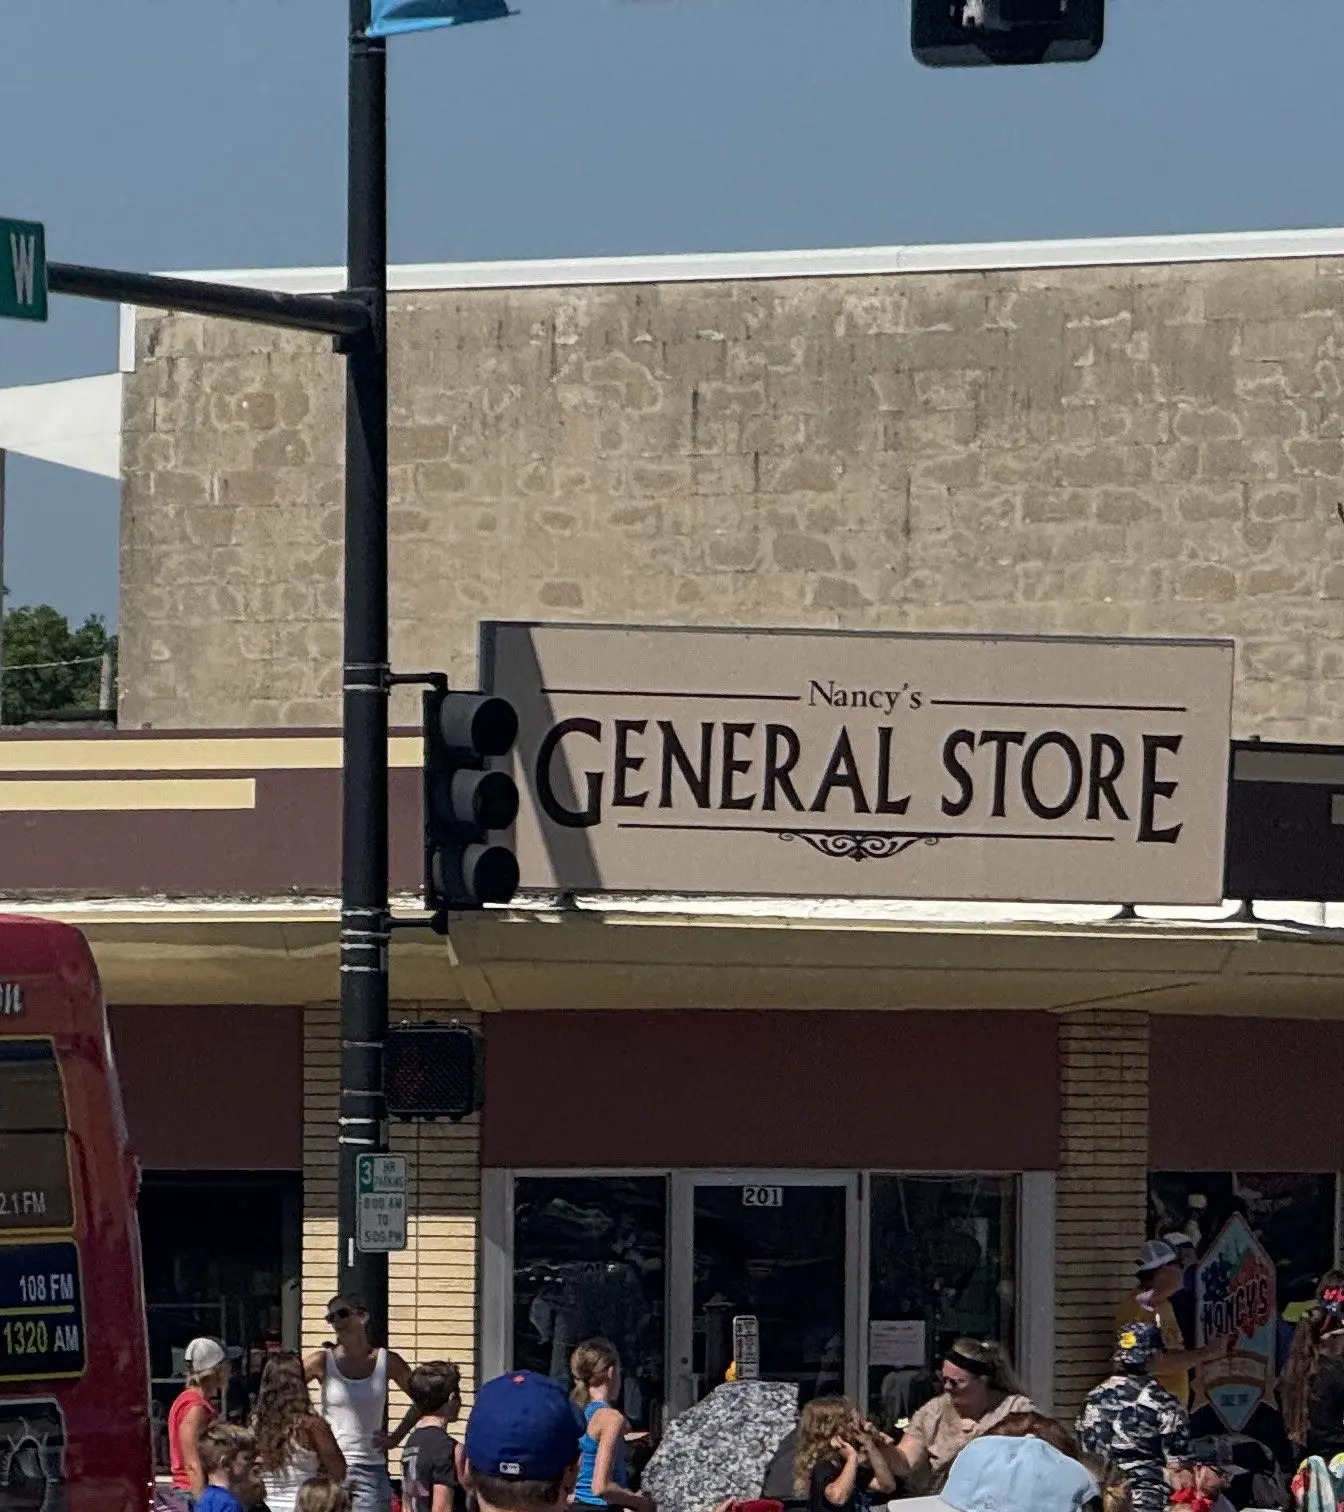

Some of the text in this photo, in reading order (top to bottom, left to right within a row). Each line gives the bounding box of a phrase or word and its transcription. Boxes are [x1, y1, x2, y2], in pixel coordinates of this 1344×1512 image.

[10, 233, 36, 305] W
[807, 680, 923, 715] Nancy's
[535, 717, 1184, 843] GENERAL STORE
[360, 1161, 373, 1185] 3
[22, 1190, 47, 1214] FM
[745, 1187, 779, 1205] 201
[19, 1275, 47, 1302] 108
[50, 1273, 73, 1299] FM
[2, 1322, 48, 1354] 1320
[54, 1325, 80, 1352] AM
